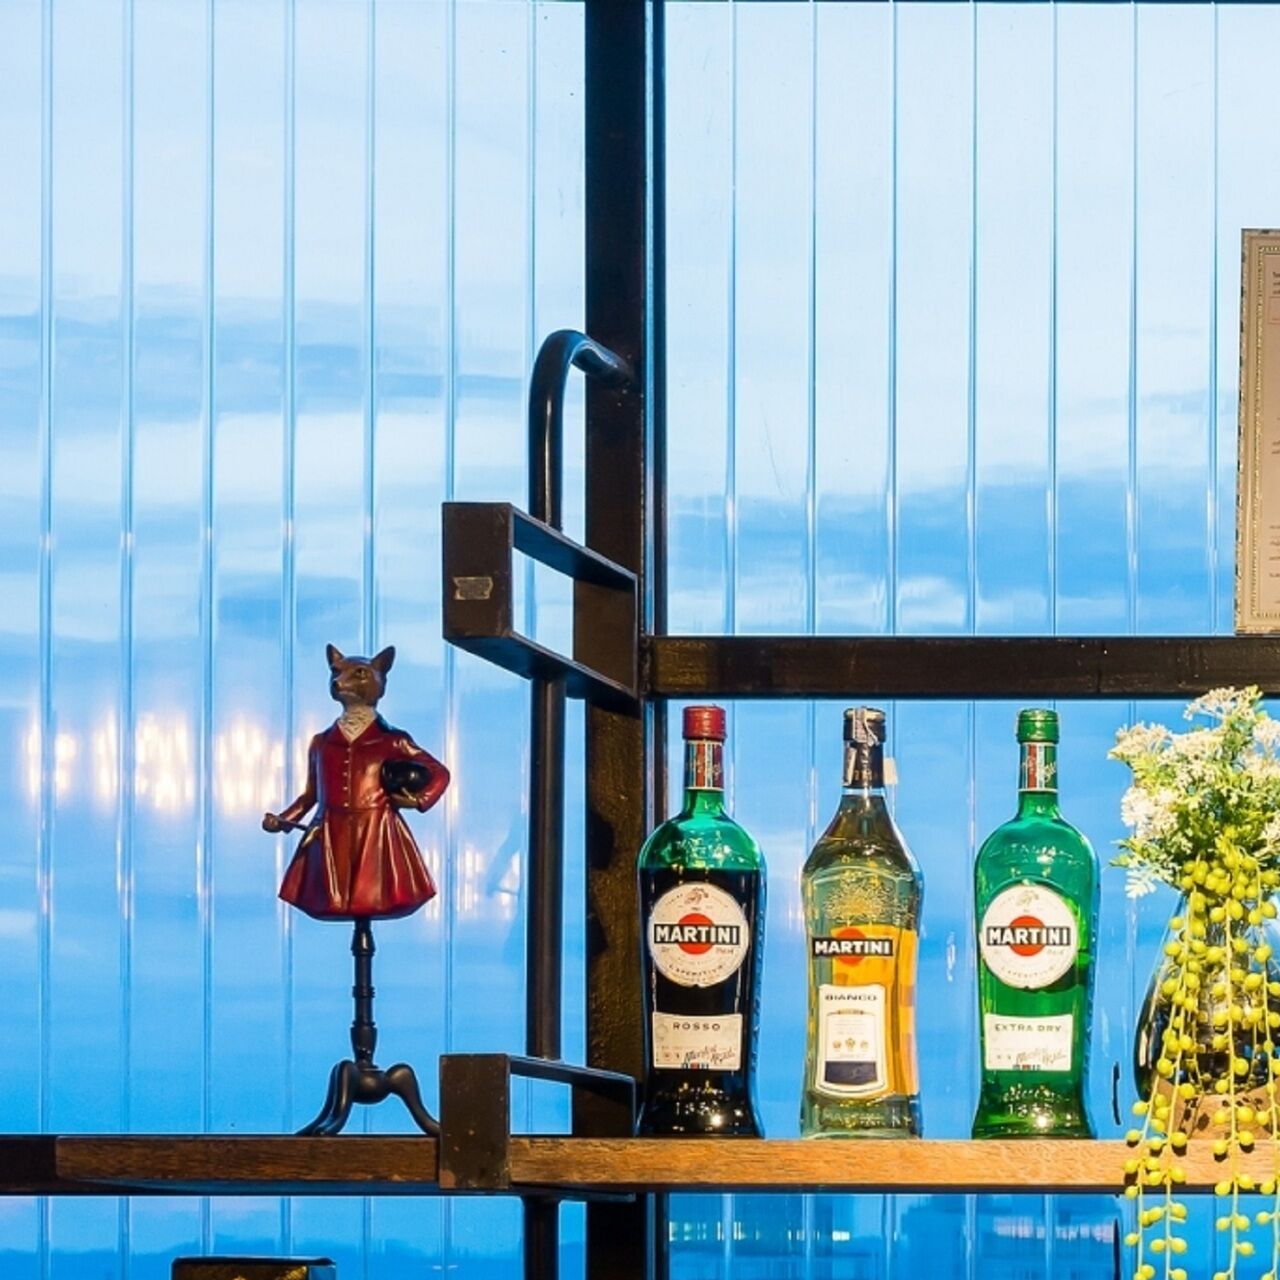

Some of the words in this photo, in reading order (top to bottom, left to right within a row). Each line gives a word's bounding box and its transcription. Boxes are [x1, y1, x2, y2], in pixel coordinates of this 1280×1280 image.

[655, 926, 738, 945] MARTINI
[987, 927, 1069, 945] MARTINI
[814, 940, 891, 954] MARTINI
[824, 993, 878, 1002] BIANCO
[673, 1022, 721, 1031] ROSSO
[995, 1023, 1033, 1032] EXTRA
[1036, 1024, 1062, 1032] DRY
